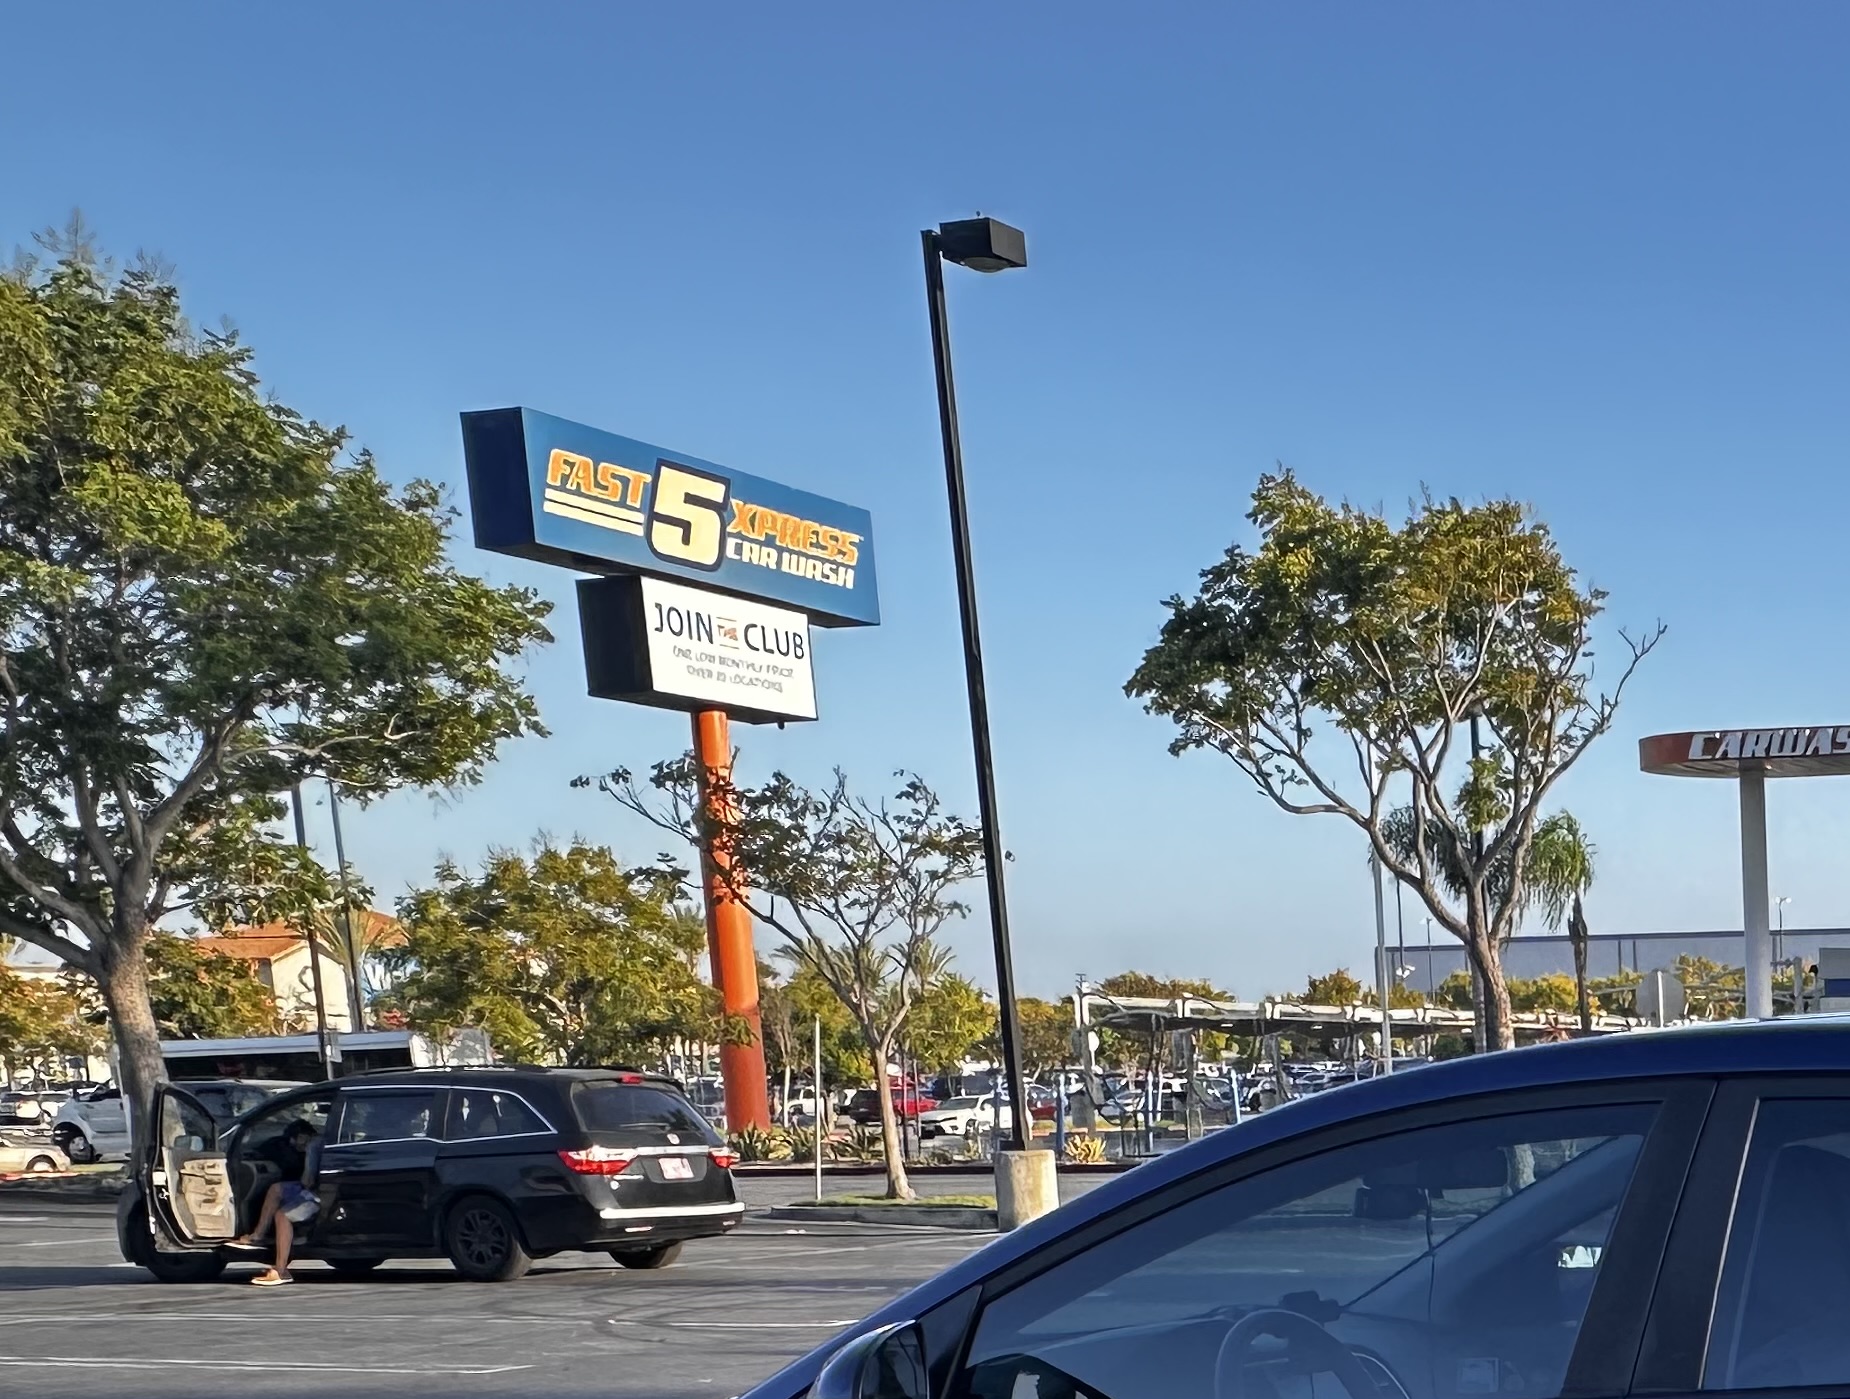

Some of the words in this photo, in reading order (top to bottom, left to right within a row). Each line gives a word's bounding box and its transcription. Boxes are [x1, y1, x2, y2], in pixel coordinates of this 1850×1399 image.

[546, 448, 652, 508] FAST
[646, 457, 731, 572] 5
[727, 498, 861, 566] XPRESS
[726, 537, 778, 570] CAR
[781, 552, 855, 590] WASH
[654, 602, 714, 645] JOIN
[743, 623, 805, 660] CLUB
